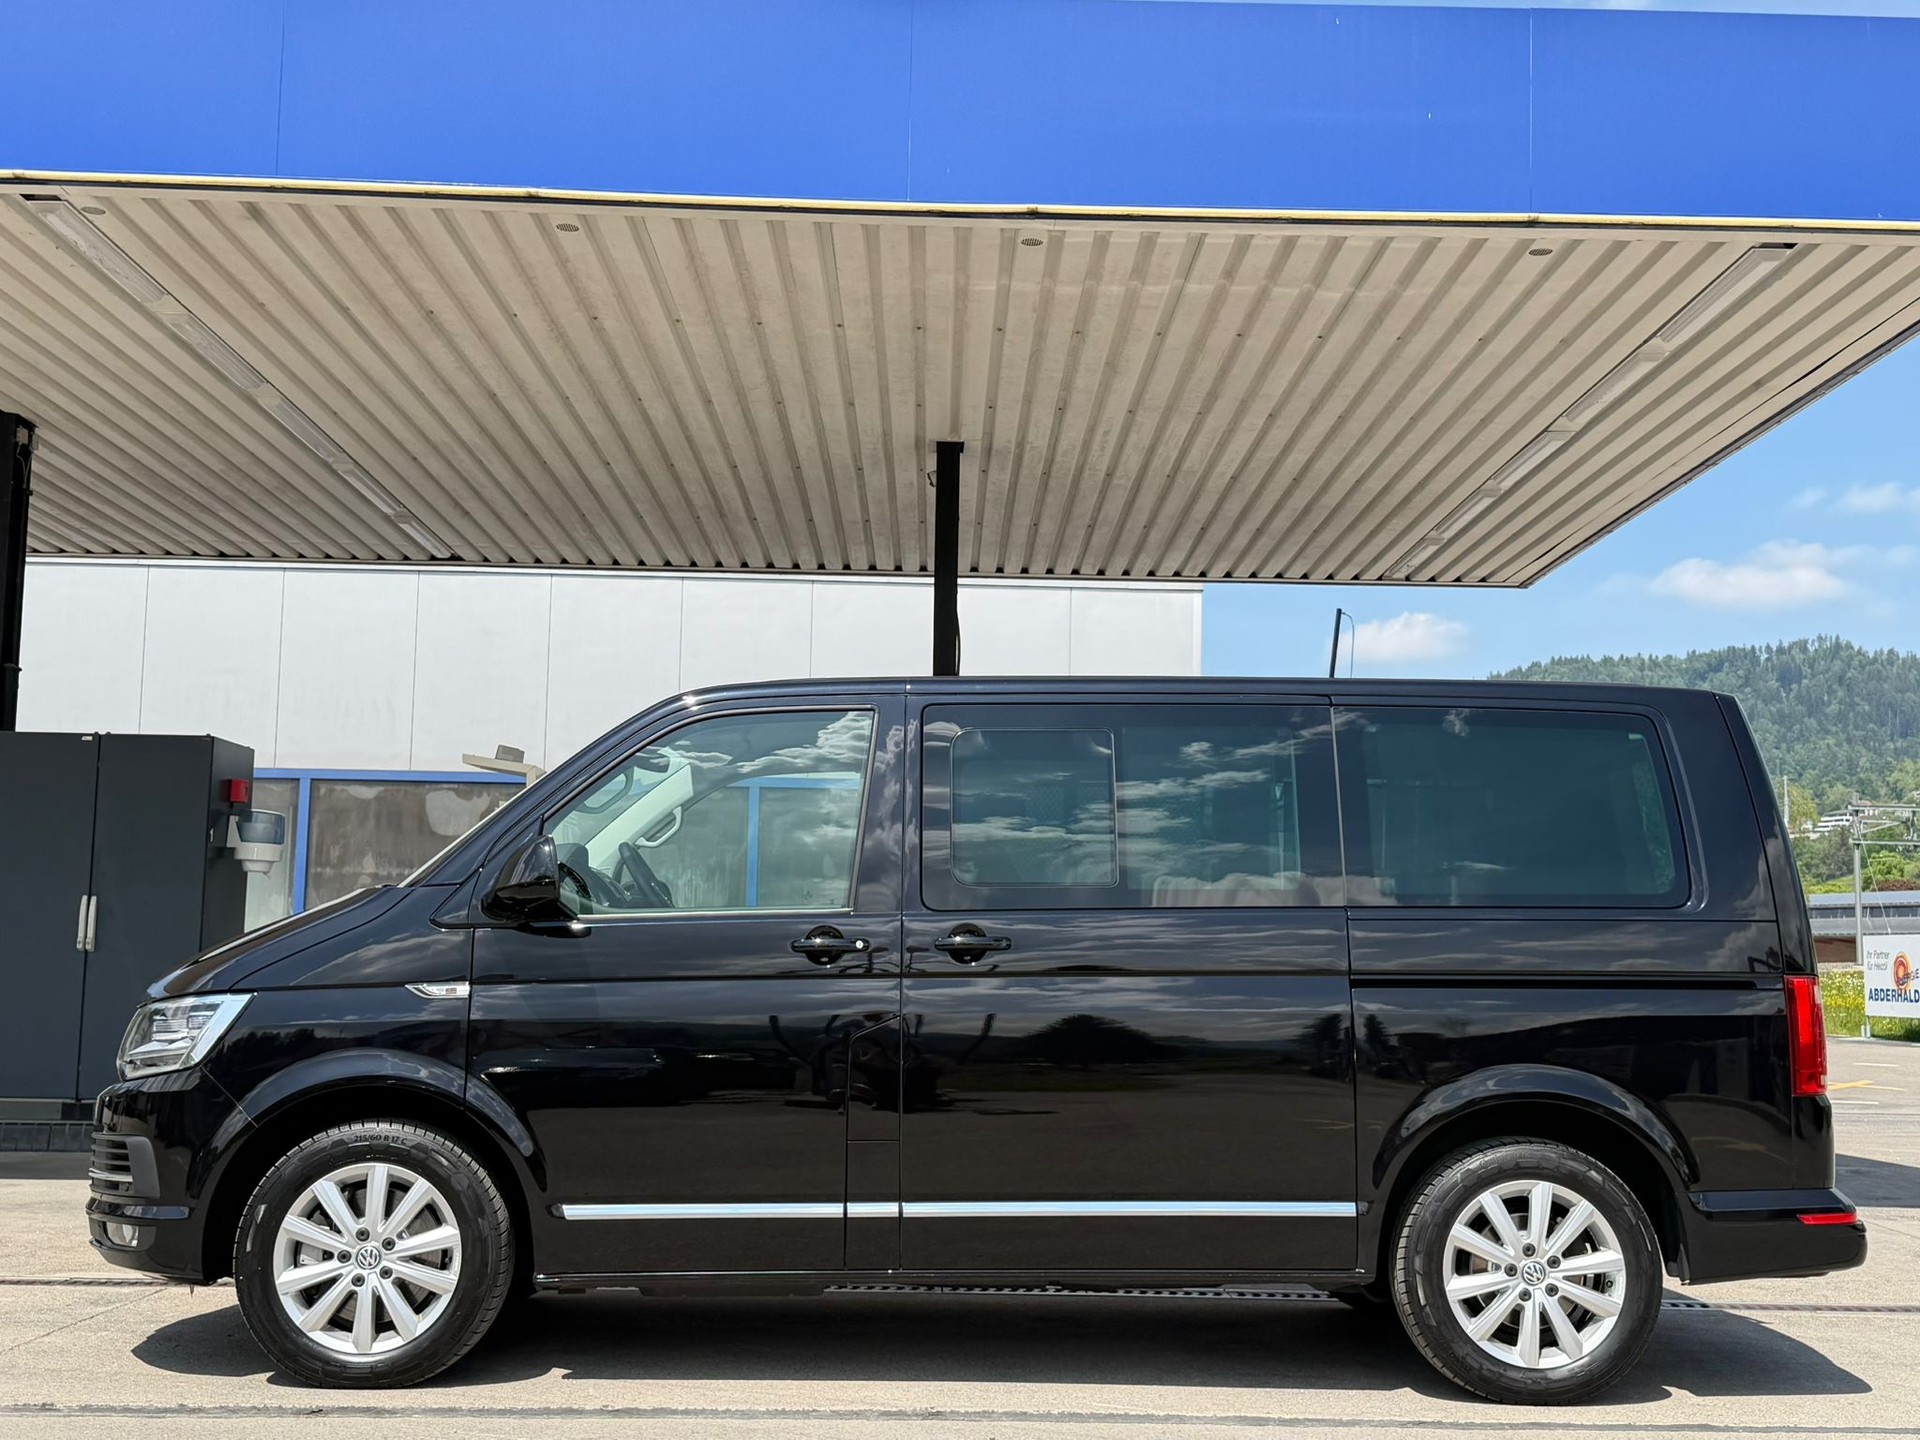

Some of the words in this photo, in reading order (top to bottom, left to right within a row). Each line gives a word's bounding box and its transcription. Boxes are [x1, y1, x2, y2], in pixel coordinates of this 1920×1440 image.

[1873, 950, 1890, 960] Partner
[1868, 988, 1920, 1003] ABDERHALD
[353, 1134, 382, 1143] 215/60
[383, 1134, 390, 1142] R
[391, 1135, 400, 1144] 17
[401, 1137, 408, 1146] C
